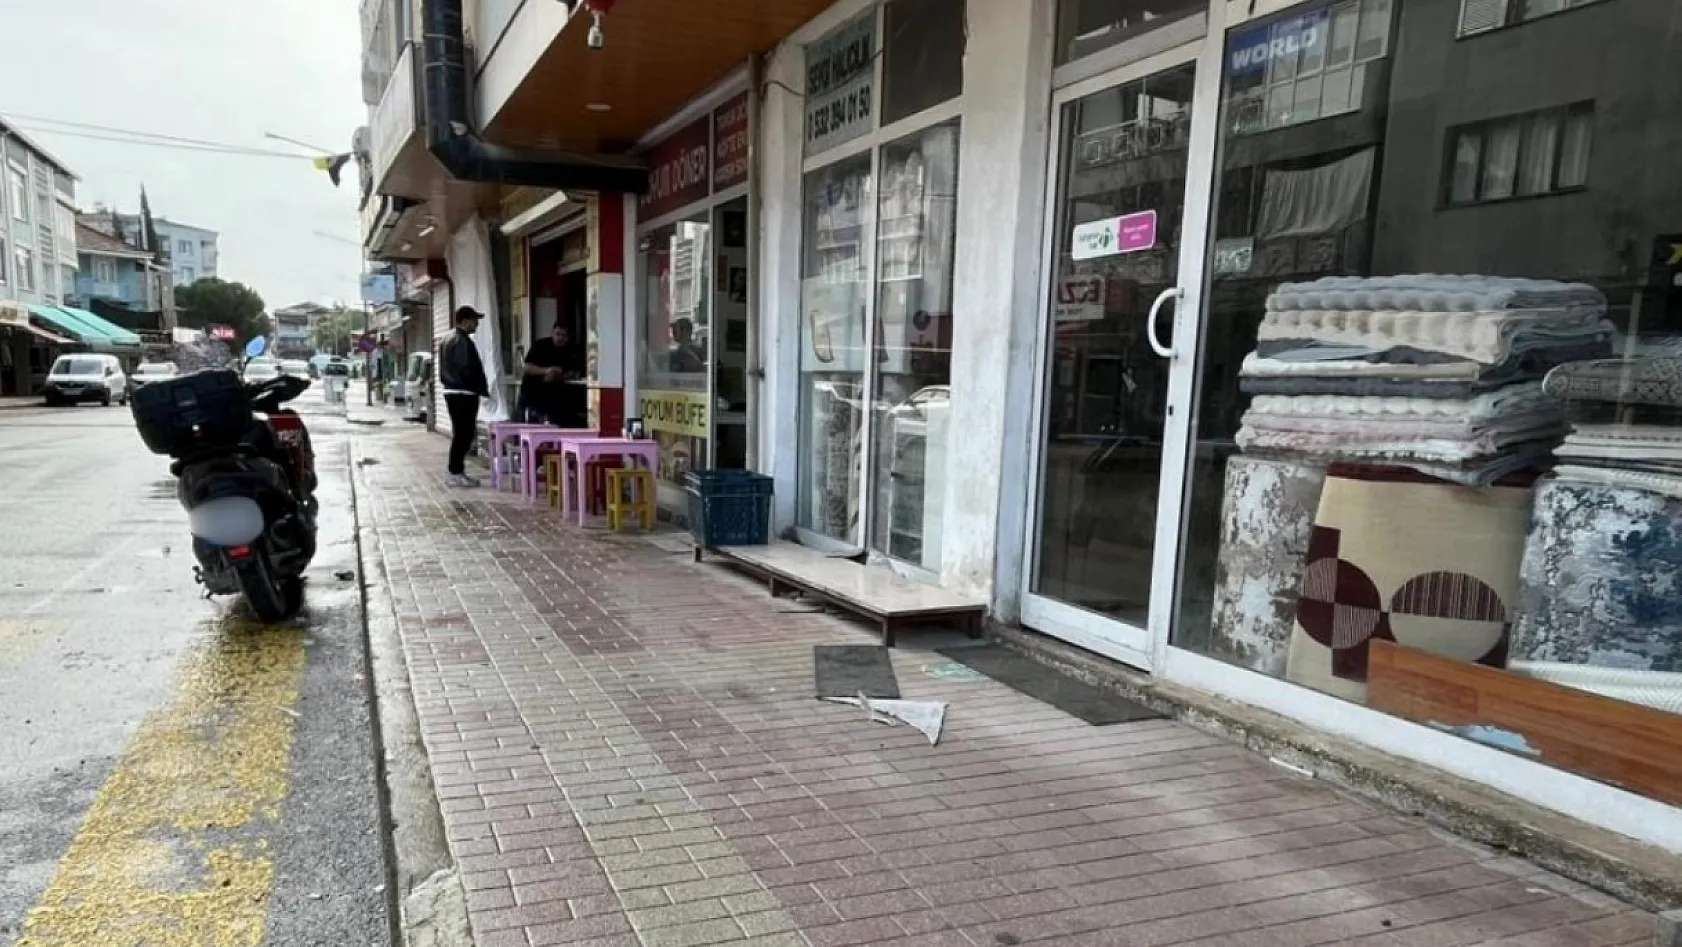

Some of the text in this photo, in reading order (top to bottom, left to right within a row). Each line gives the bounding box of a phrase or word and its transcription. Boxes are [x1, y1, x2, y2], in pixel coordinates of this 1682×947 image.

[1232, 27, 1317, 69] WORLD
[815, 105, 829, 139] 532
[640, 396, 706, 427] DOYUM BÜFE
